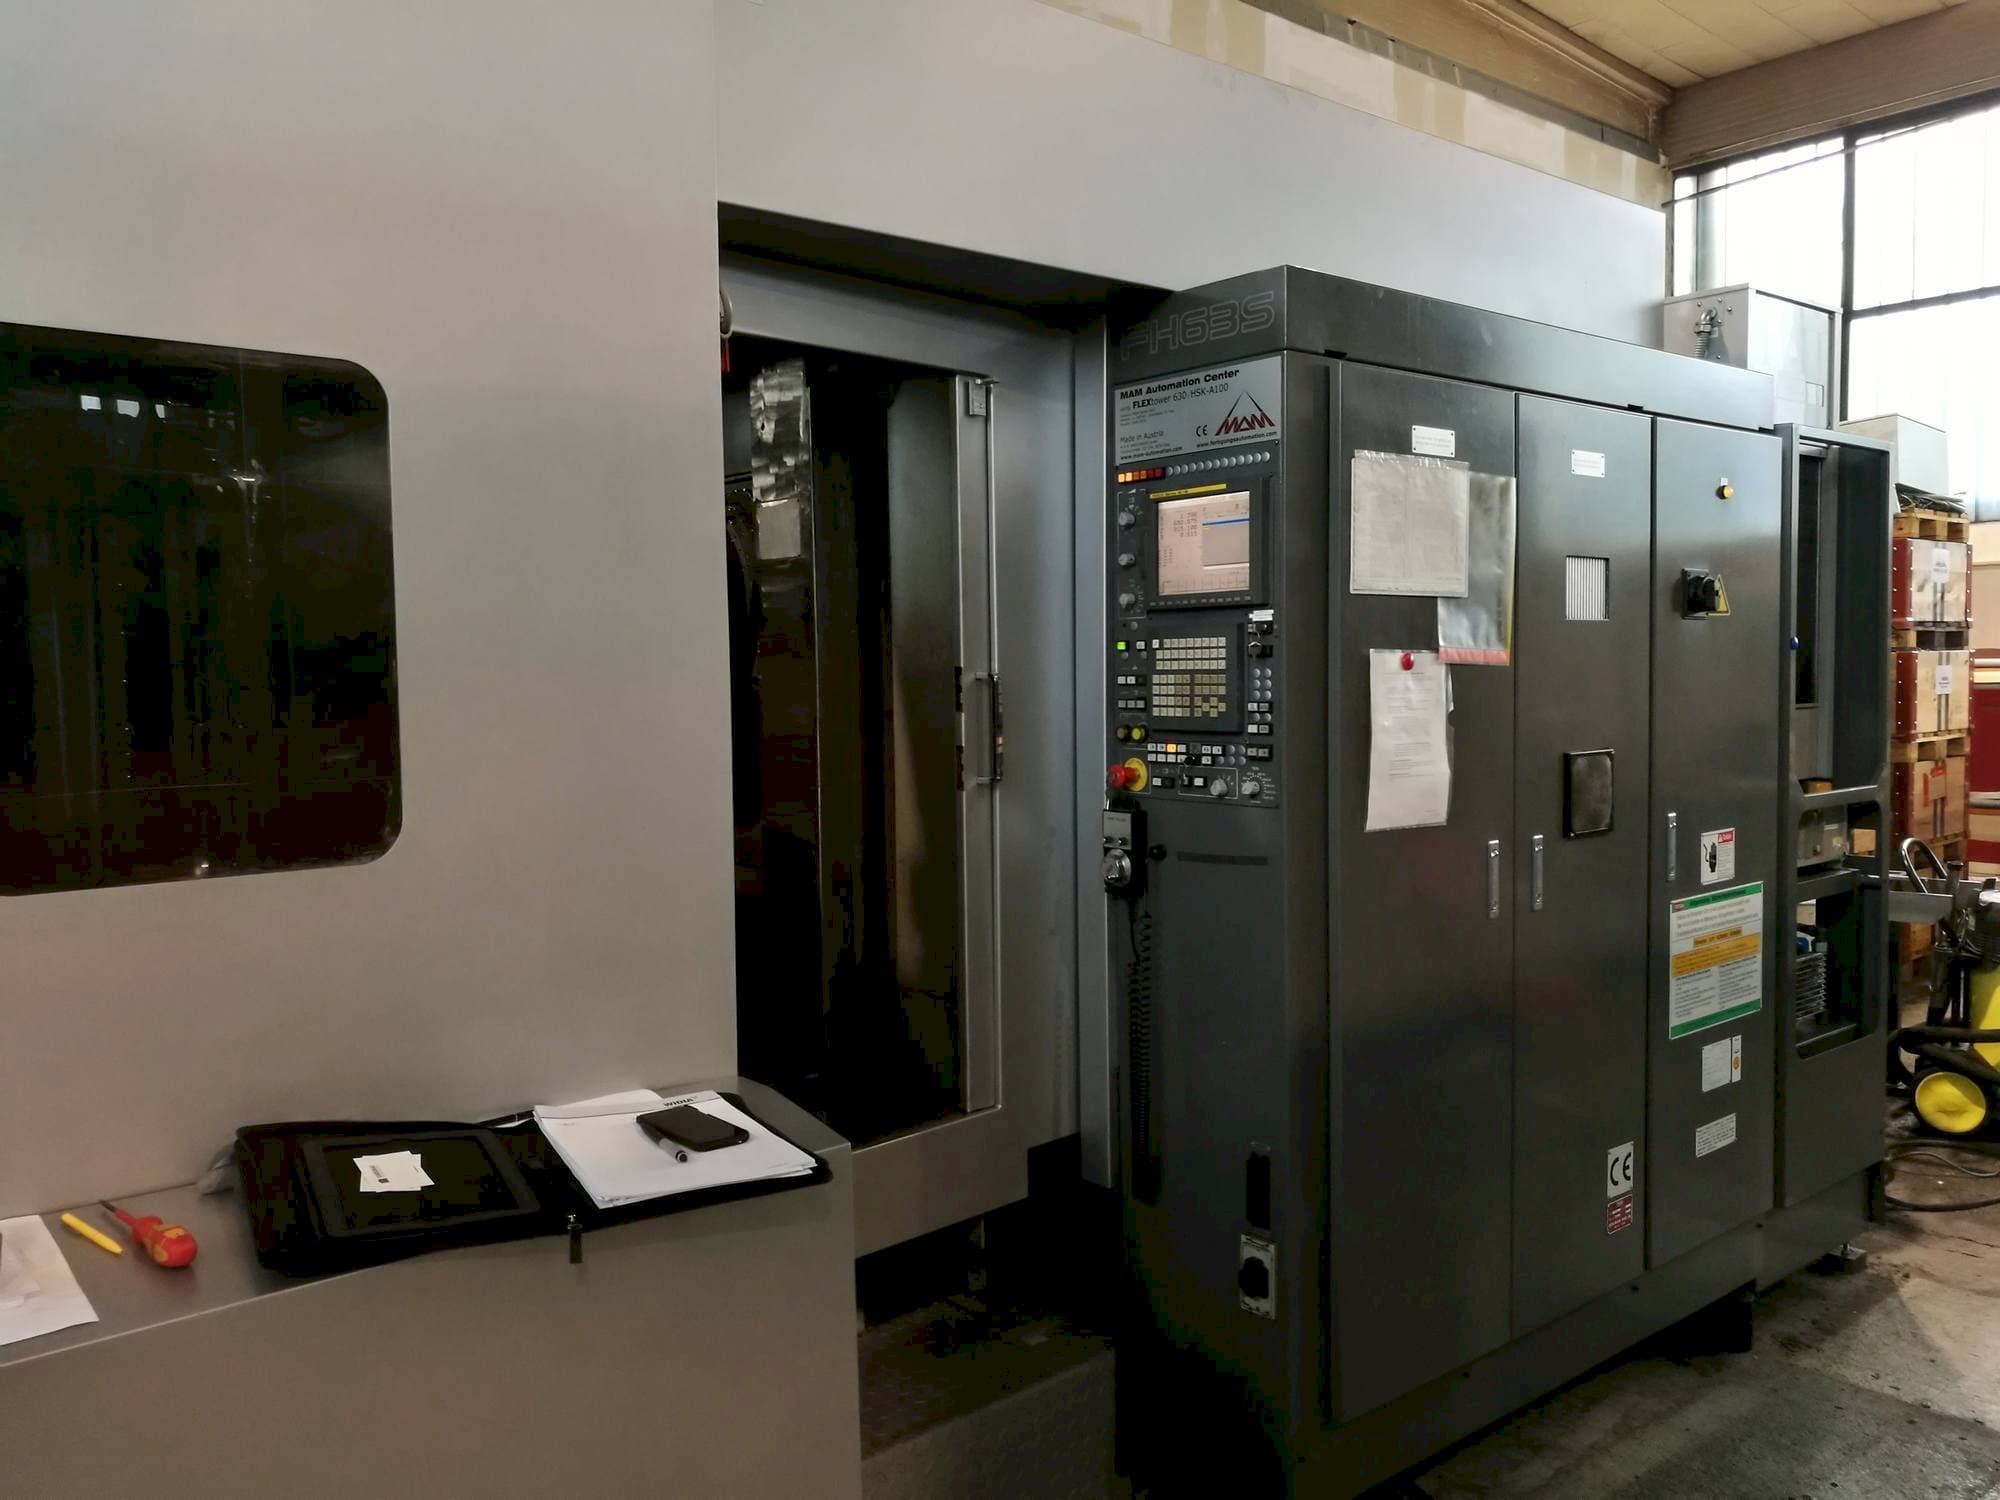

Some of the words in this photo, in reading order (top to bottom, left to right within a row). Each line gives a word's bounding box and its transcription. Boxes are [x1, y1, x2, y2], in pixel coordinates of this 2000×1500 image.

[1120, 290, 1275, 361] FH63S
[1120, 388, 1143, 400] MAM
[1146, 377, 1201, 395] Automation
[1204, 368, 1240, 383] Center
[1132, 394, 1172, 410] FLEXtower
[1195, 424, 1208, 437] CE
[1214, 412, 1276, 436] MAM
[1120, 434, 1136, 444] Made
[1143, 429, 1164, 440] Austria
[663, 1098, 694, 1107] WIDIA
[1610, 1151, 1632, 1187] CE
